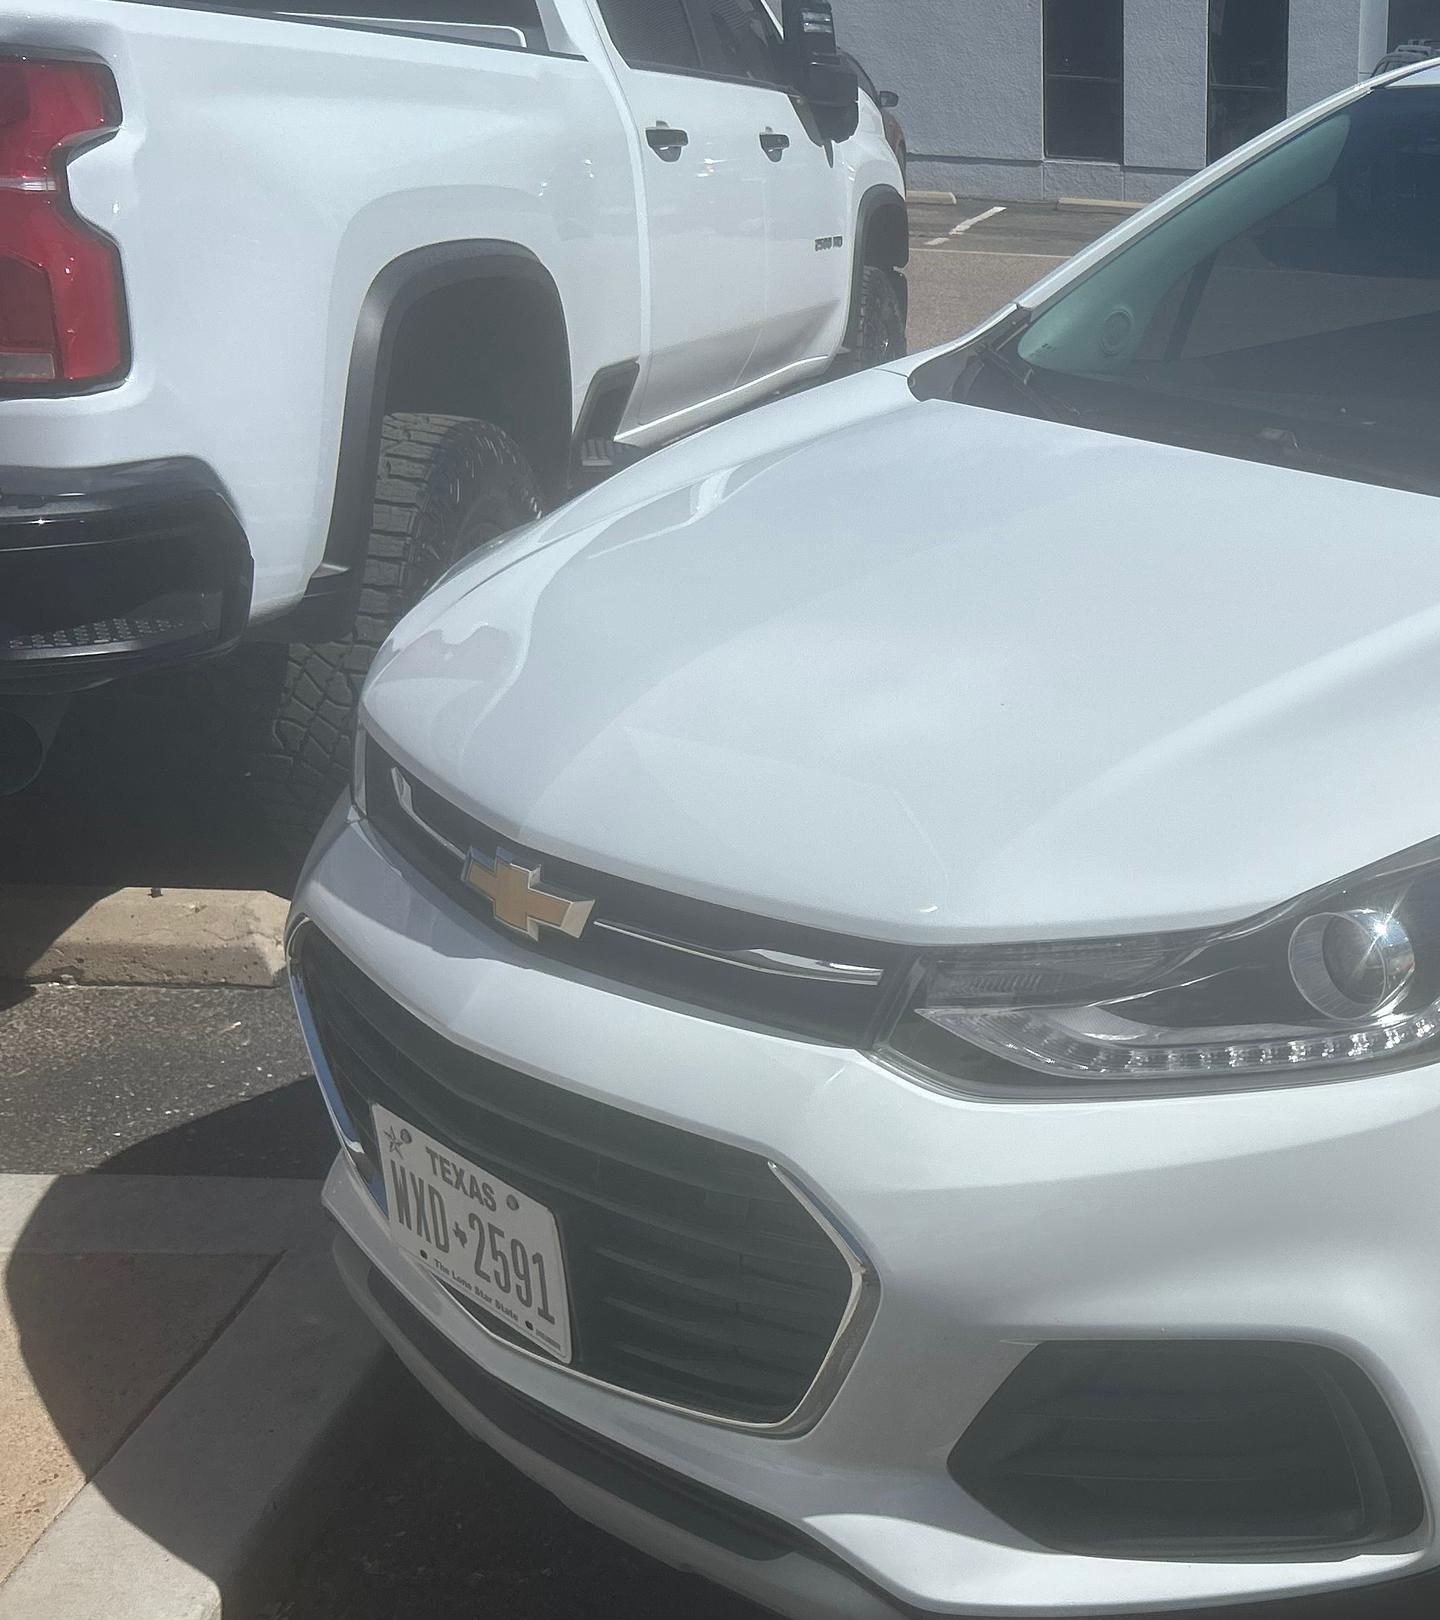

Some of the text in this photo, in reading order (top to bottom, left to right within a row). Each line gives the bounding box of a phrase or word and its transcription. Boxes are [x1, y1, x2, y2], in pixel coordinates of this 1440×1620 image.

[425, 1146, 497, 1212] TEXAS
[390, 1161, 555, 1324] WXD 2591
[434, 1258, 518, 1321] The Lone Star State
